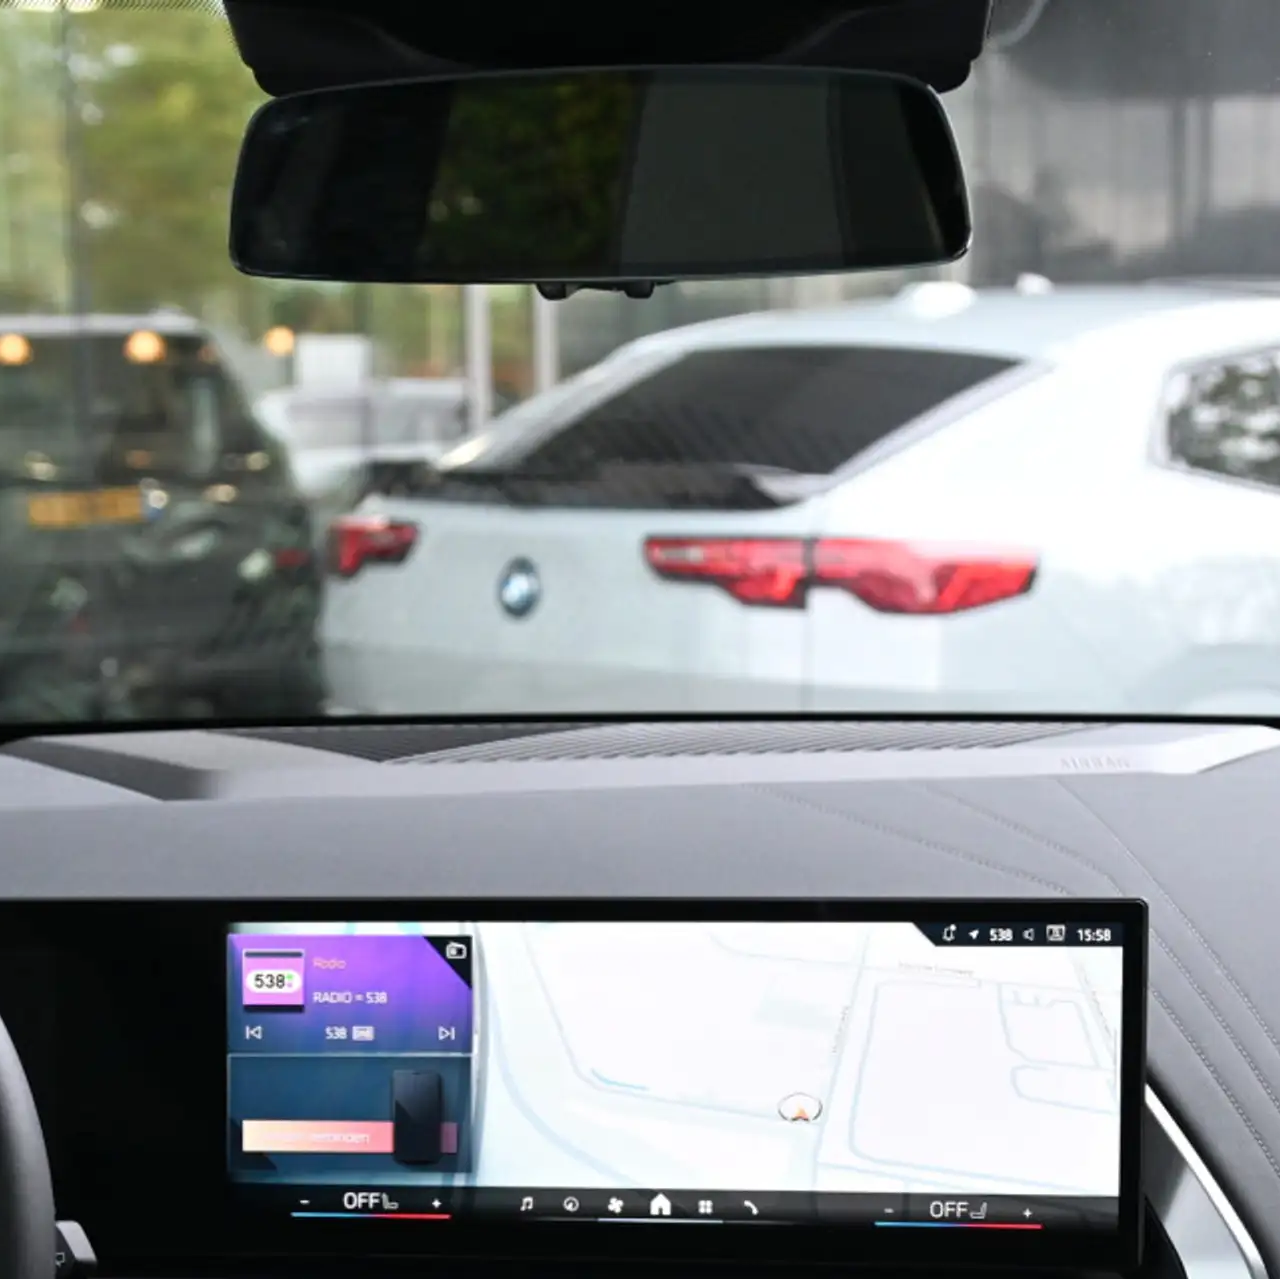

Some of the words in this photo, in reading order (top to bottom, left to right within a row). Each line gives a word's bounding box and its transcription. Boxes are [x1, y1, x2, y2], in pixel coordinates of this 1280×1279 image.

[989, 928, 1014, 942] 538
[1077, 929, 1111, 942] 15:58
[313, 958, 347, 969] Radio
[254, 973, 285, 989] 538
[313, 991, 352, 1004] RADIO
[366, 991, 388, 1004] 538
[325, 1026, 348, 1040] 538
[344, 1191, 381, 1210] OFF
[930, 1201, 969, 1219] OFF
